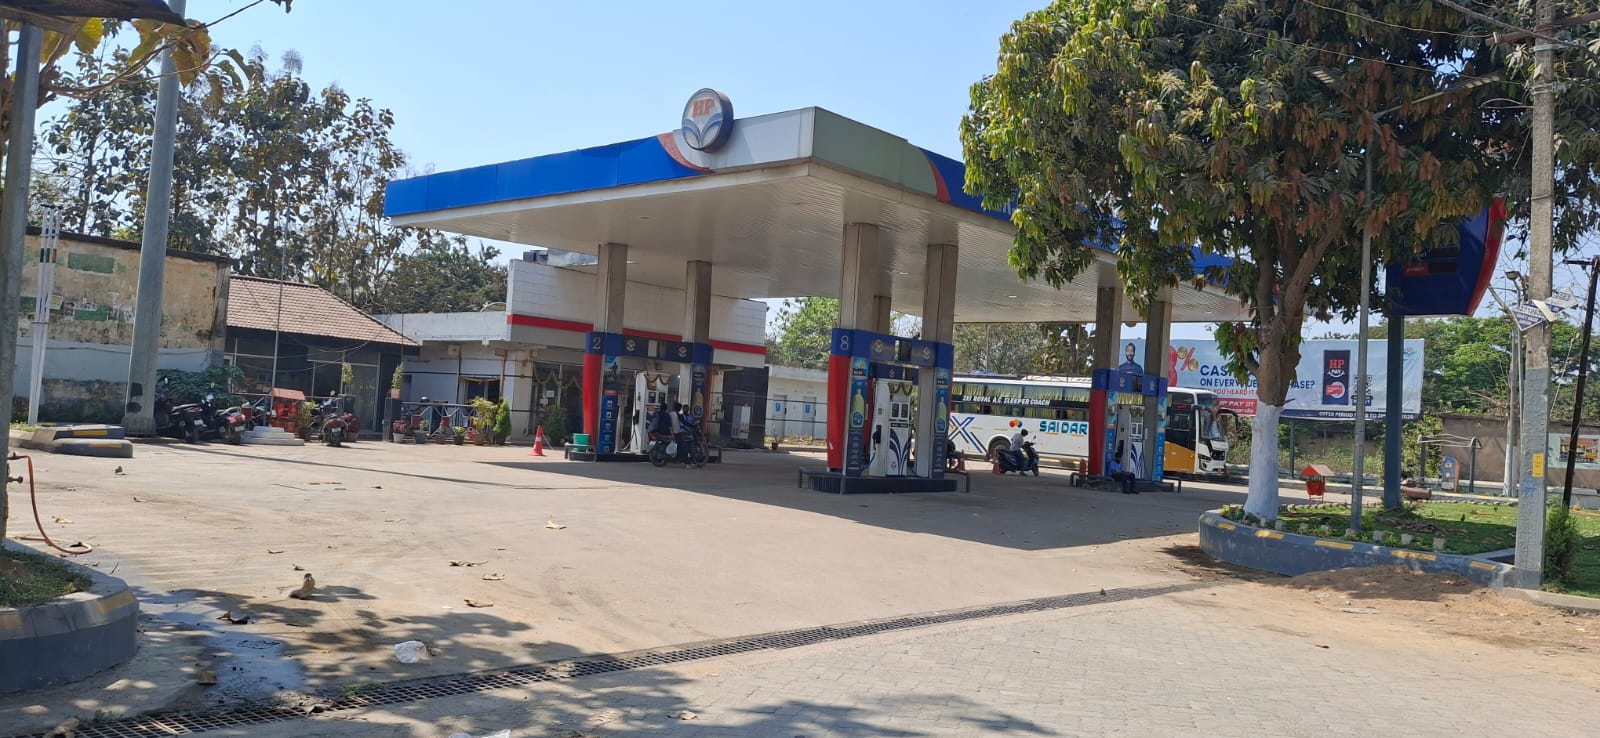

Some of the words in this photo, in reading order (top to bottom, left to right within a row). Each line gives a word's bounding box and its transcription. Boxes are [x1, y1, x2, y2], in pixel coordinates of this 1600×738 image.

[692, 97, 715, 118] HP
[592, 336, 601, 350] 2
[840, 335, 849, 351] 8
[1329, 359, 1345, 369] HP
[1201, 378, 1213, 387] ON
[1003, 397, 1030, 406] SLEEPER
[1030, 398, 1051, 406] COACH
